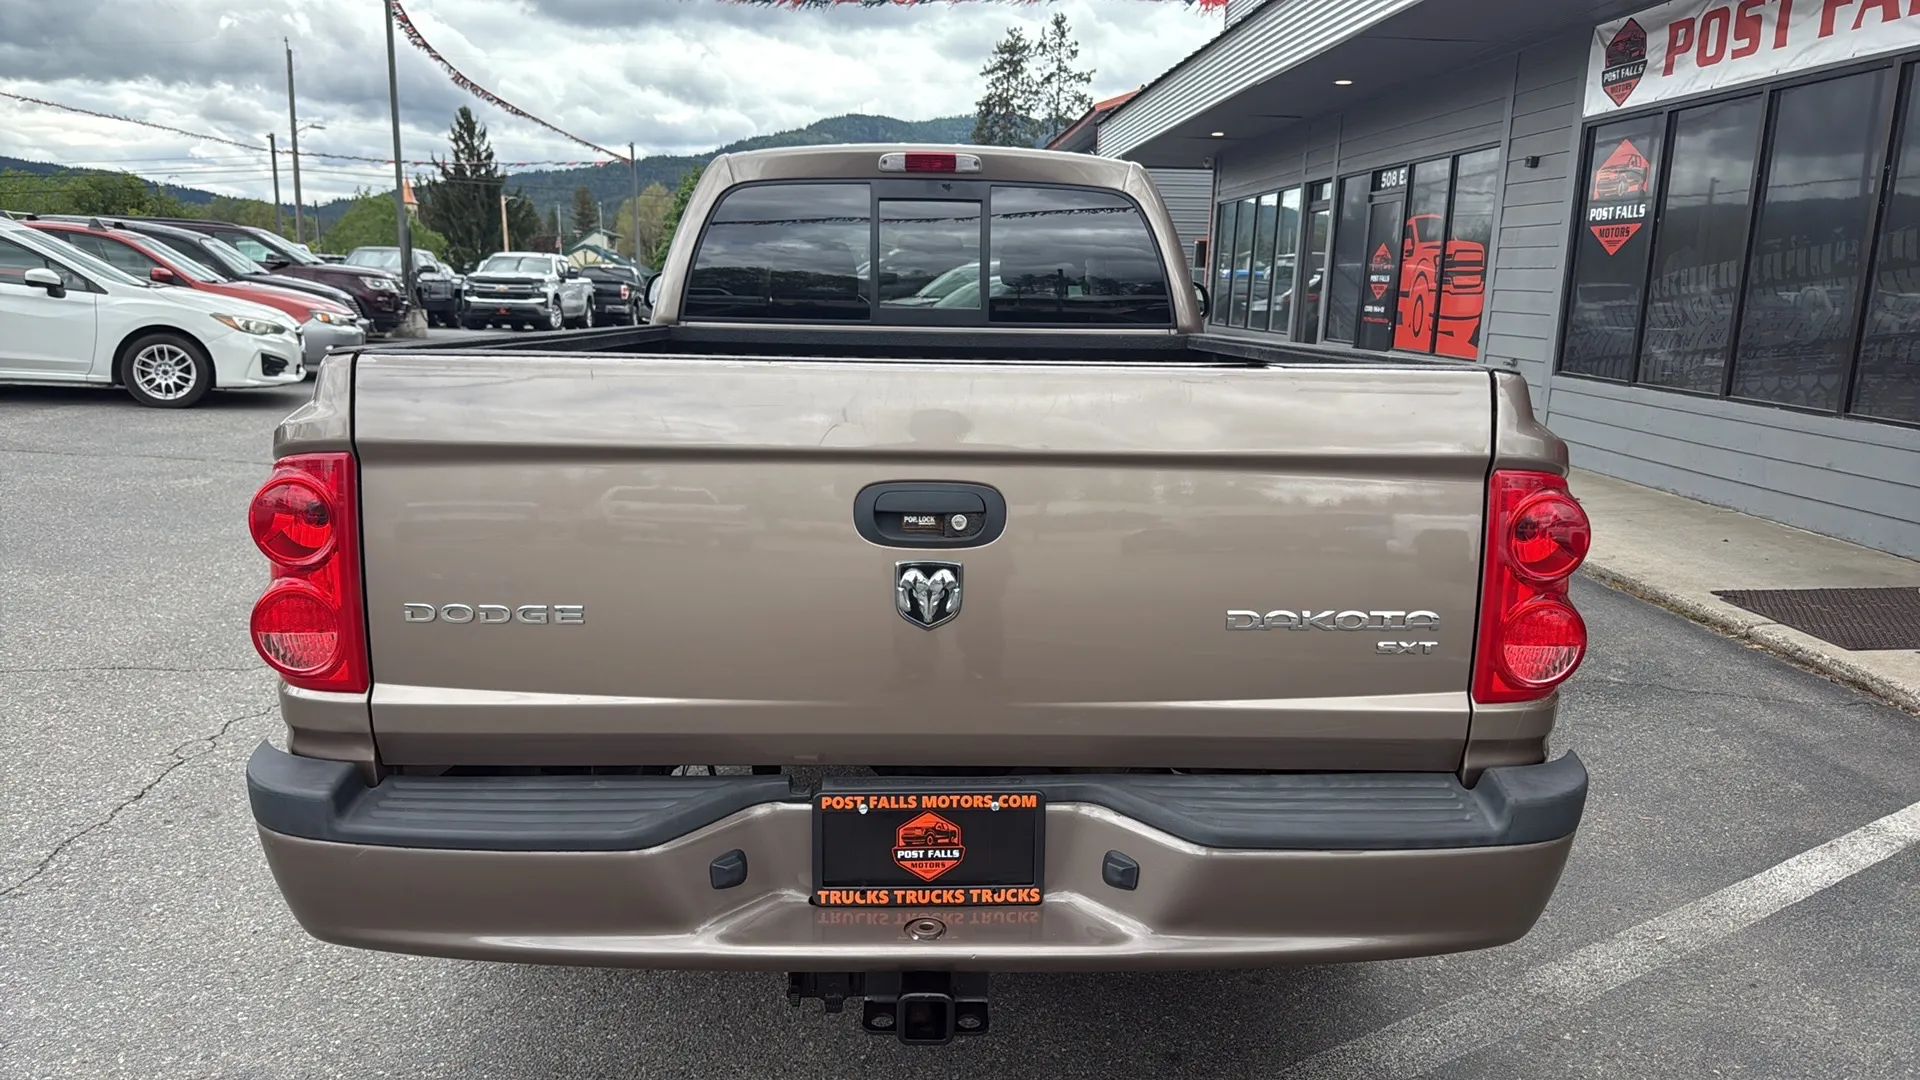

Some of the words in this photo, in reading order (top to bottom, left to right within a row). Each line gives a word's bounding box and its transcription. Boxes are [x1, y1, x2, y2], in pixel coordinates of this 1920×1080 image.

[1662, 0, 1793, 77] POST
[1818, 0, 1920, 39] FA
[1603, 70, 1620, 84] POST
[1621, 63, 1645, 79] FALLS
[1381, 170, 1397, 188] 508
[1590, 206, 1614, 221] POST
[1615, 204, 1646, 220] FALLS
[1599, 226, 1630, 238] MOTORS
[404, 603, 586, 625] DODGE
[1226, 609, 1440, 631] DAKOTA
[1376, 641, 1438, 655] SXT
[821, 796, 865, 809] POST
[869, 795, 918, 809] FALLS
[921, 795, 1037, 809] MOTORSCOM
[897, 850, 925, 859] POST
[927, 849, 960, 858] FALLS
[817, 890, 889, 905] TRUCKS
[894, 890, 965, 904] TRUCKS
[969, 888, 1041, 903] TRUCKS
